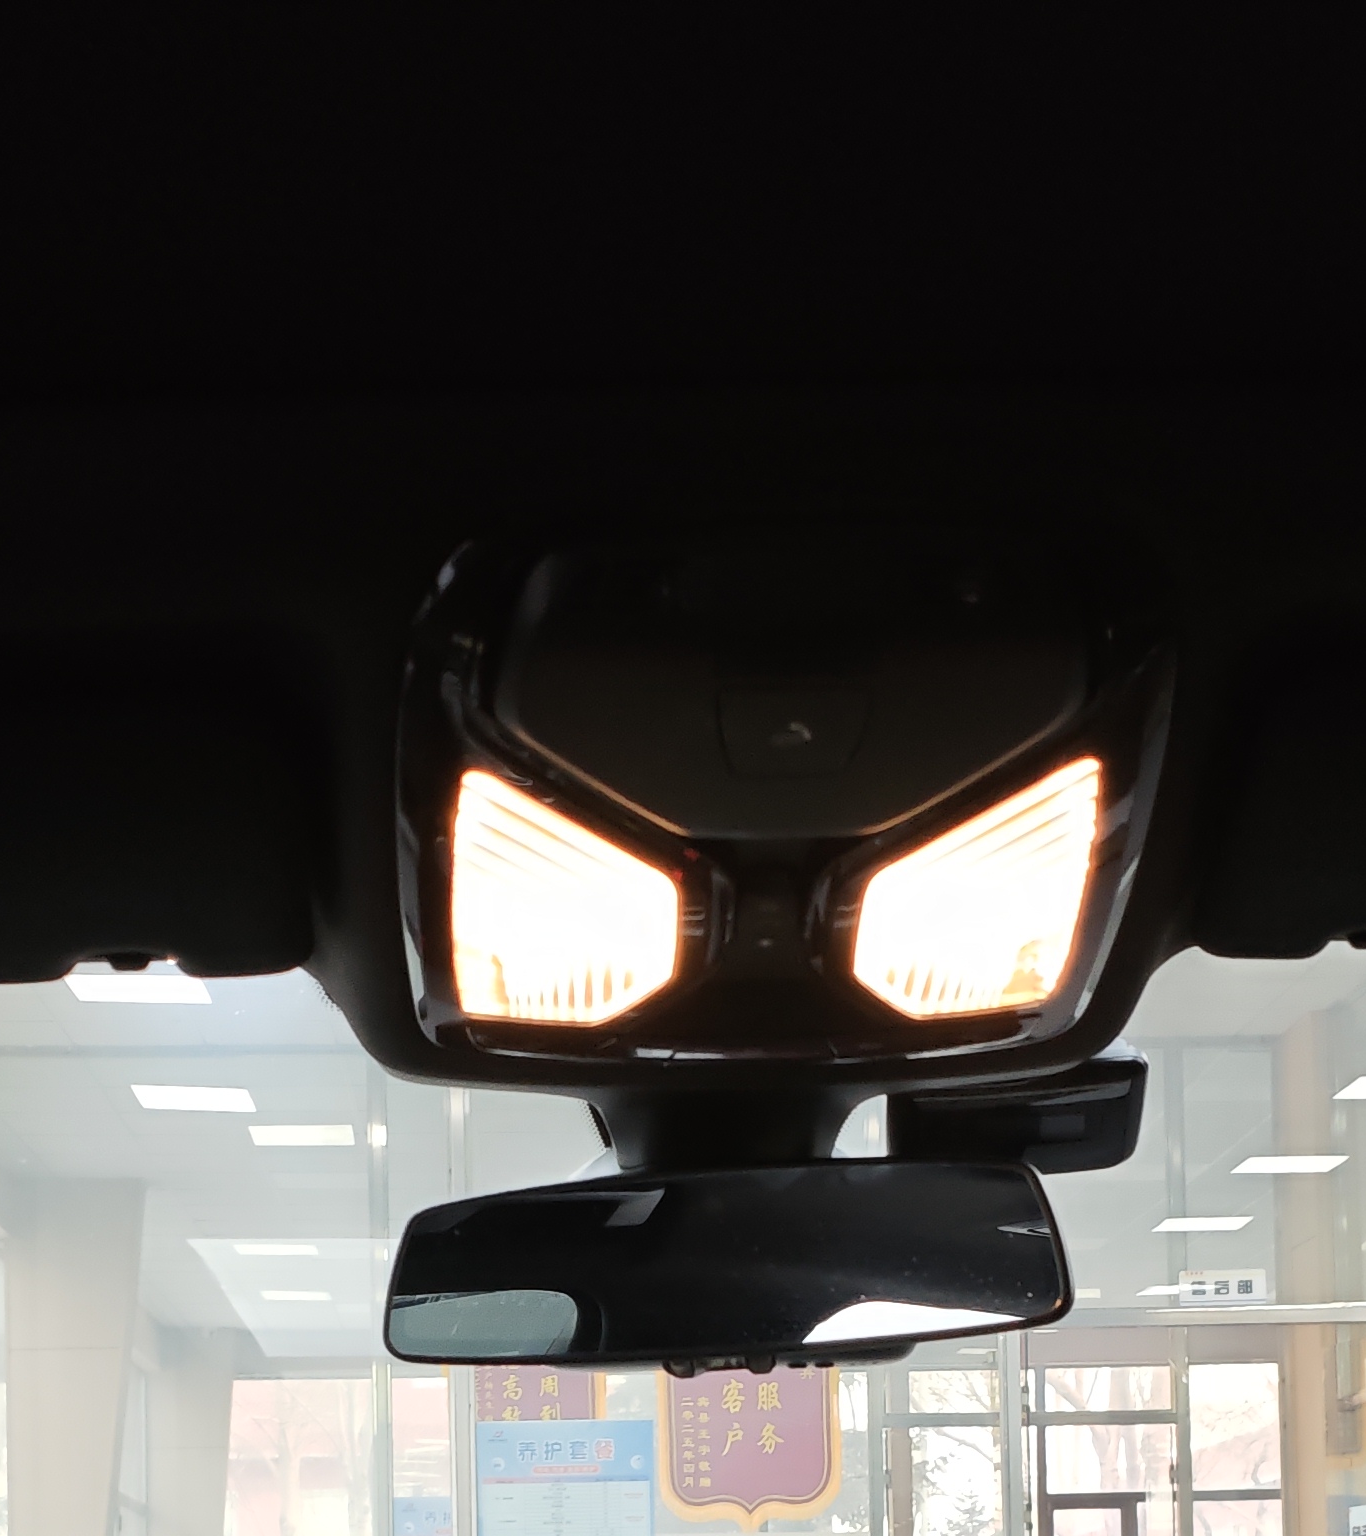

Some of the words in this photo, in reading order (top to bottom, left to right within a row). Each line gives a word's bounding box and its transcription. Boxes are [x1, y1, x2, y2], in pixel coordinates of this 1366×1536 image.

[517, 1439, 615, 1461] 养护套餐
[721, 1379, 746, 1456] 客户
[757, 1381, 785, 1454] 服务
